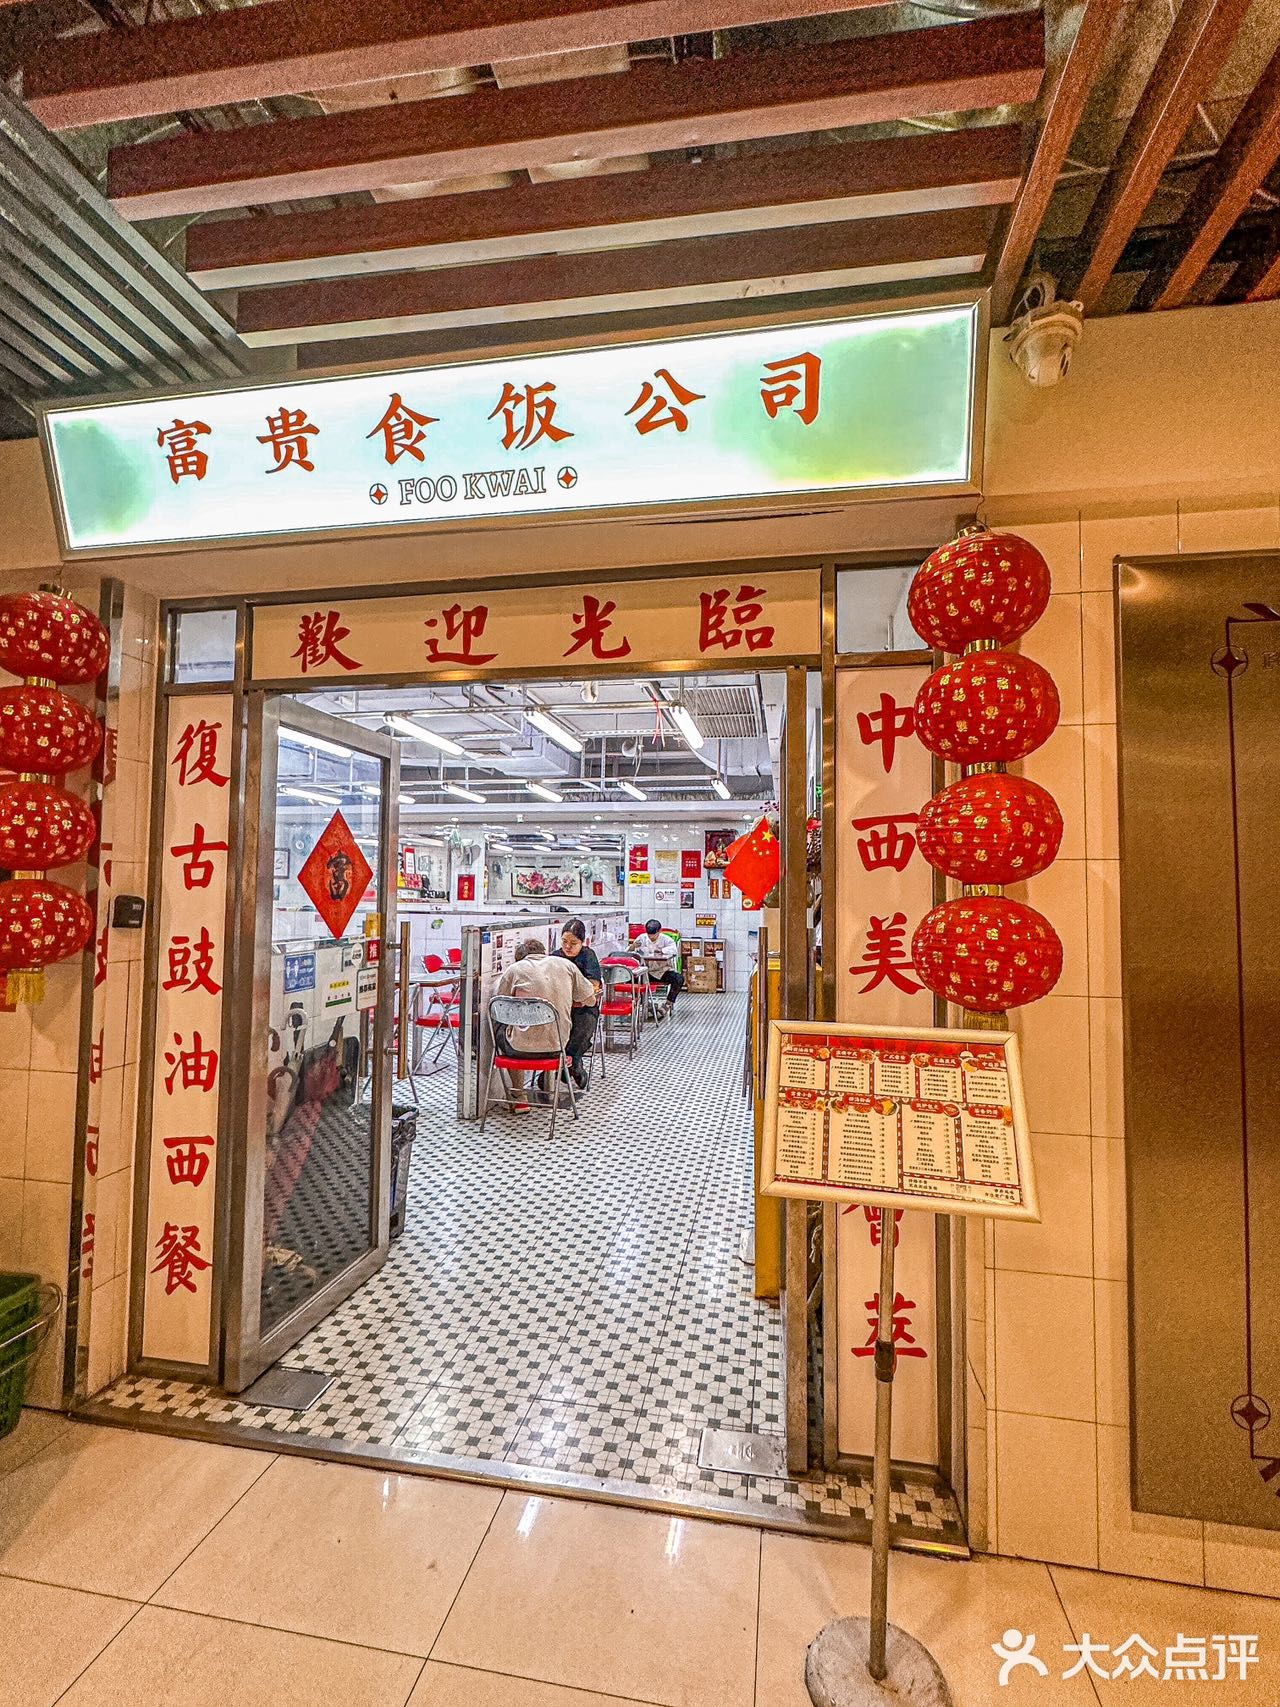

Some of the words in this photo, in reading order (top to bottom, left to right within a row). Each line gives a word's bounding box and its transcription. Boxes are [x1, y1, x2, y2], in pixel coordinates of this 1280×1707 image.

[157, 352, 822, 485] 富贵食饭公司
[398, 476, 457, 505] FOO
[463, 466, 547, 500] KWAI
[290, 585, 775, 674] 歡迎光臨
[150, 719, 232, 1297] 復古豉油西餐
